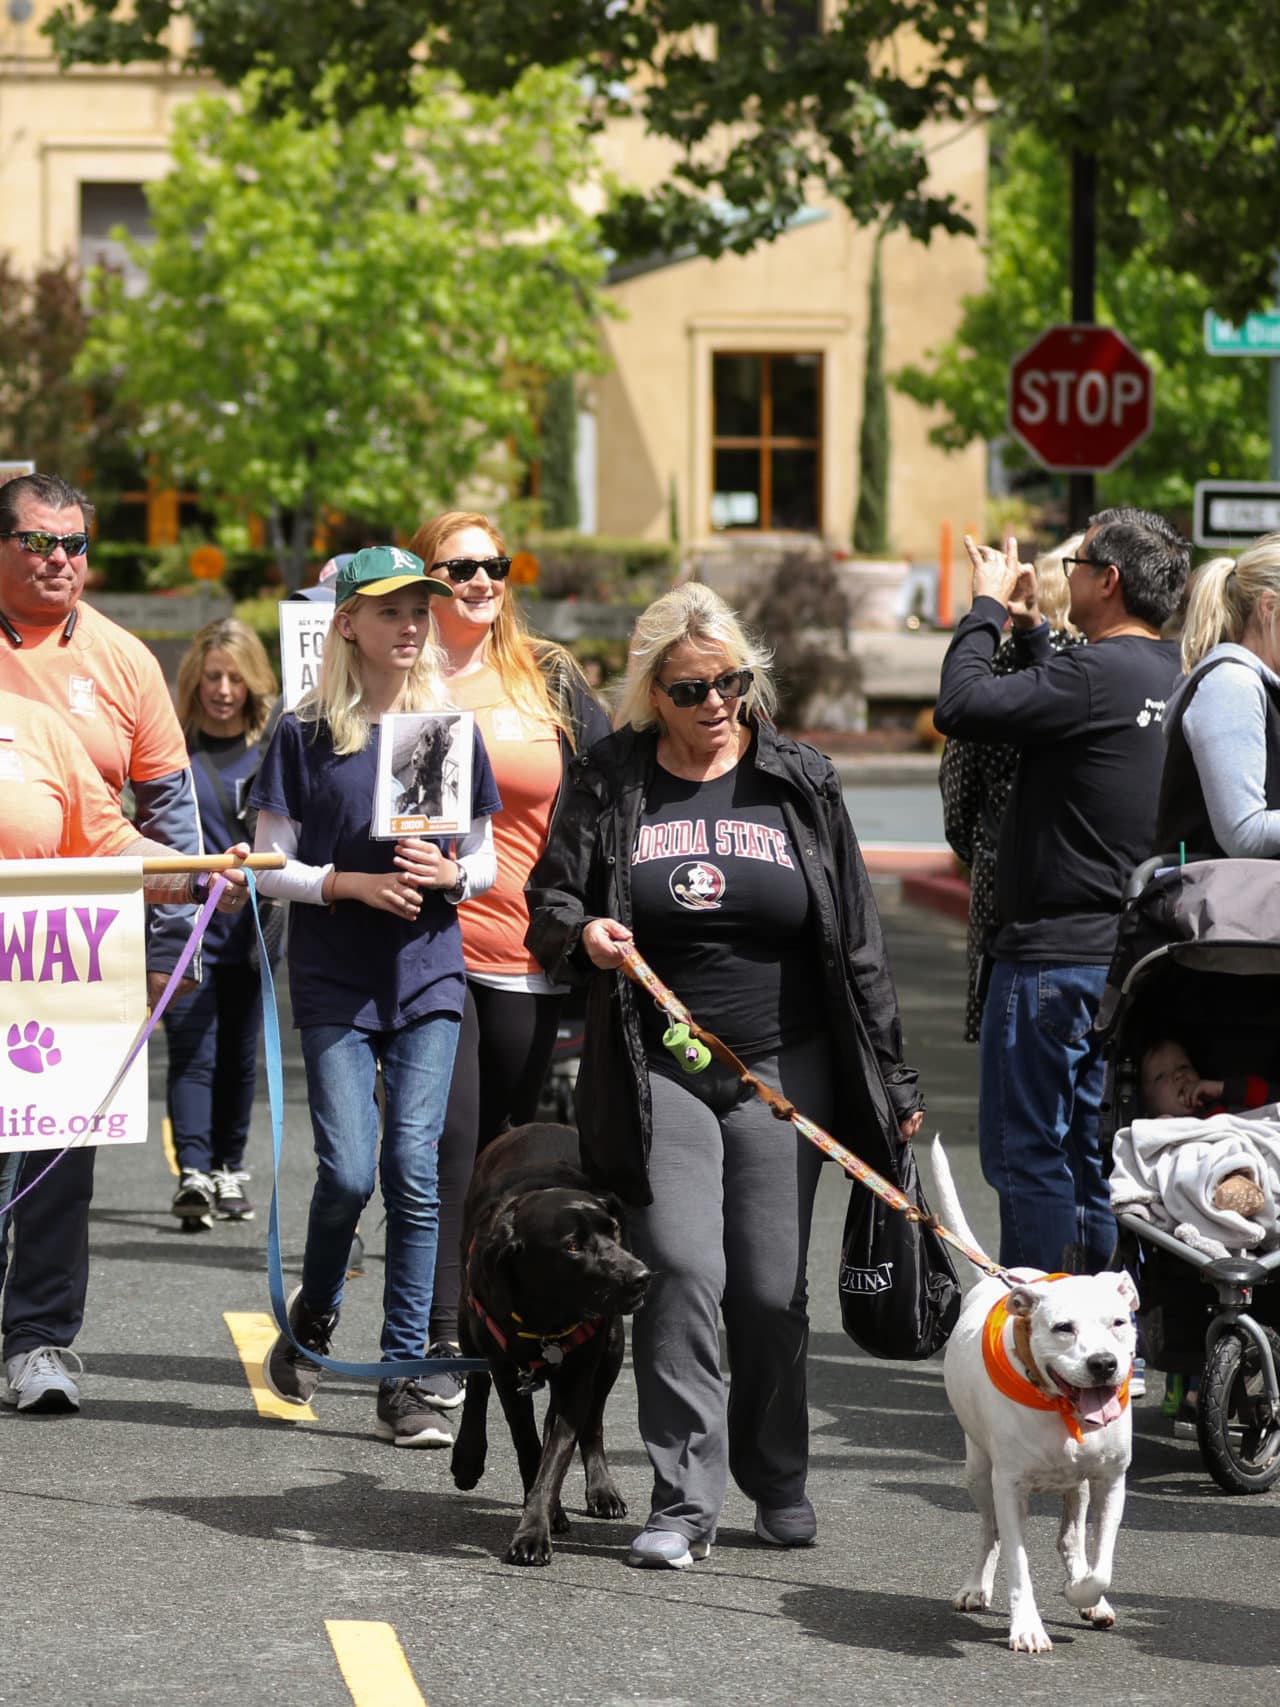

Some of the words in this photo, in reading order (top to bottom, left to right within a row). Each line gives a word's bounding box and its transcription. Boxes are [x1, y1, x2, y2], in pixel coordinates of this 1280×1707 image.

[1017, 370, 1144, 428] STOP
[632, 819, 709, 866] ORIDA
[715, 819, 795, 871] STATE
